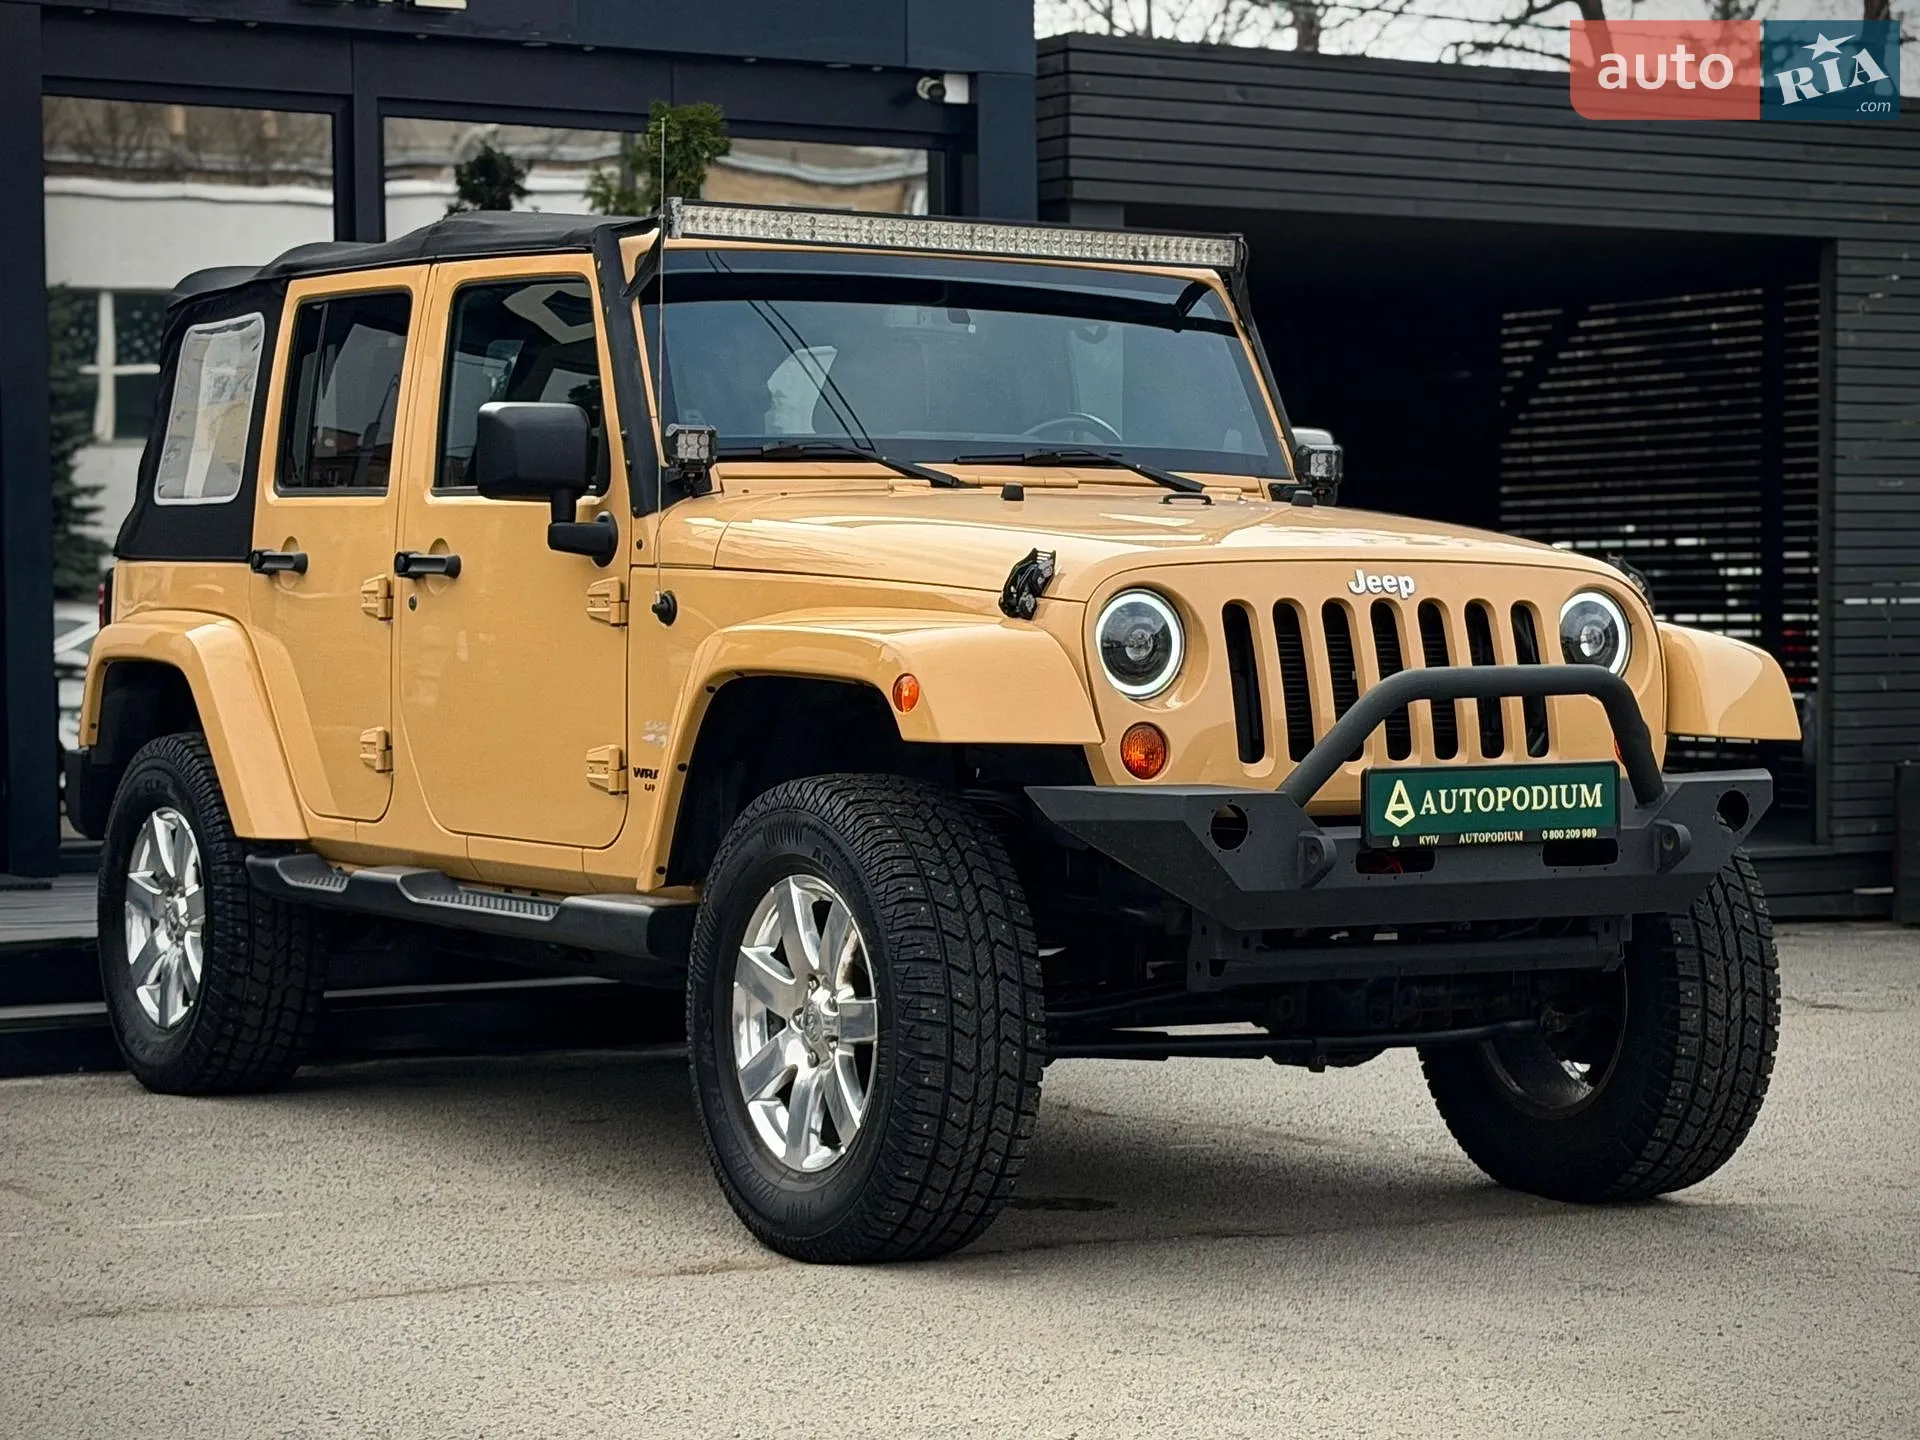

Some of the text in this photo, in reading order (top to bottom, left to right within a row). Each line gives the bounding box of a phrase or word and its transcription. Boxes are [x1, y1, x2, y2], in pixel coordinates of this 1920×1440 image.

[1347, 568, 1416, 599] Jeep
[1419, 783, 1603, 815] AUTOPODIUM
[1419, 835, 1440, 846] KYIV
[1459, 831, 1524, 844] AUTOPODIUM
[1549, 829, 1565, 840] 800
[1565, 828, 1581, 839] 209
